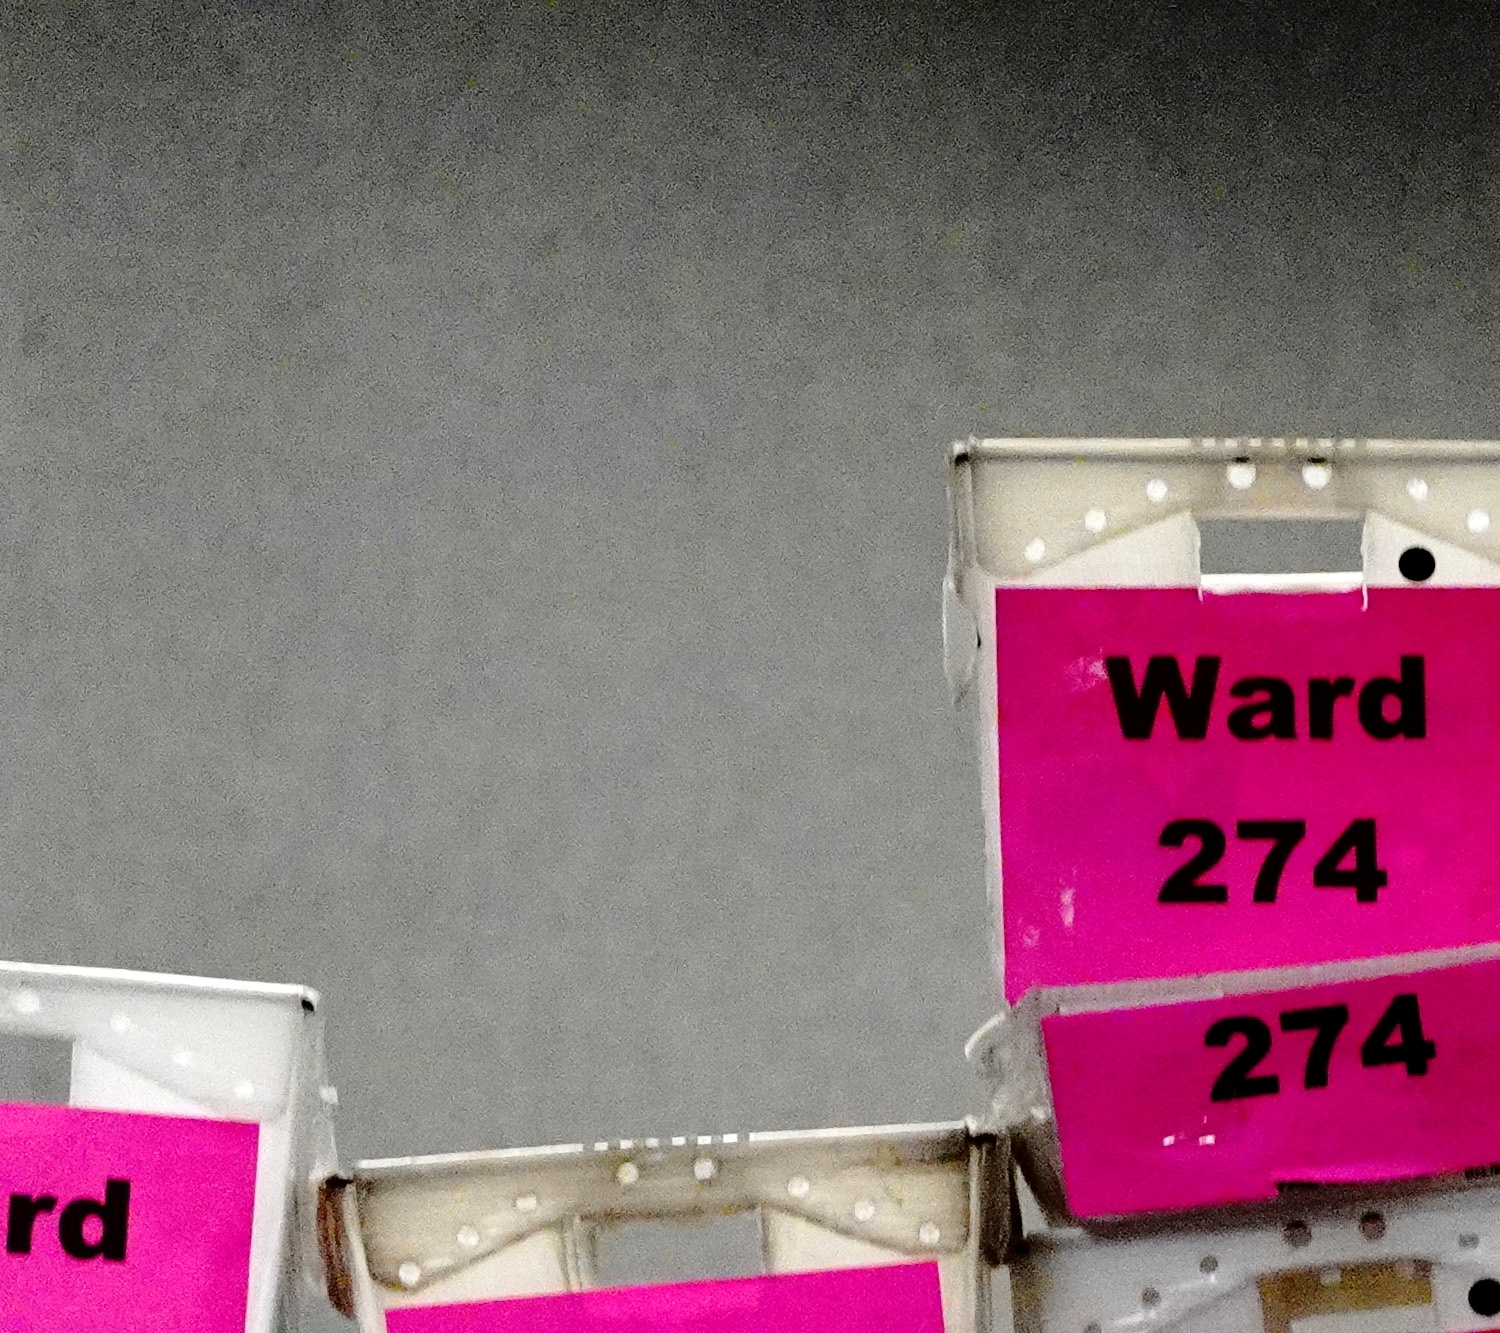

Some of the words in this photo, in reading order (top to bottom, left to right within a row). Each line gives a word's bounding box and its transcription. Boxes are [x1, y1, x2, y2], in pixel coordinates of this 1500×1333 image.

[1106, 656, 1426, 740] Ward
[1158, 819, 1387, 903] 274
[1205, 994, 1436, 1102] 274
[7, 1179, 130, 1261] rd
